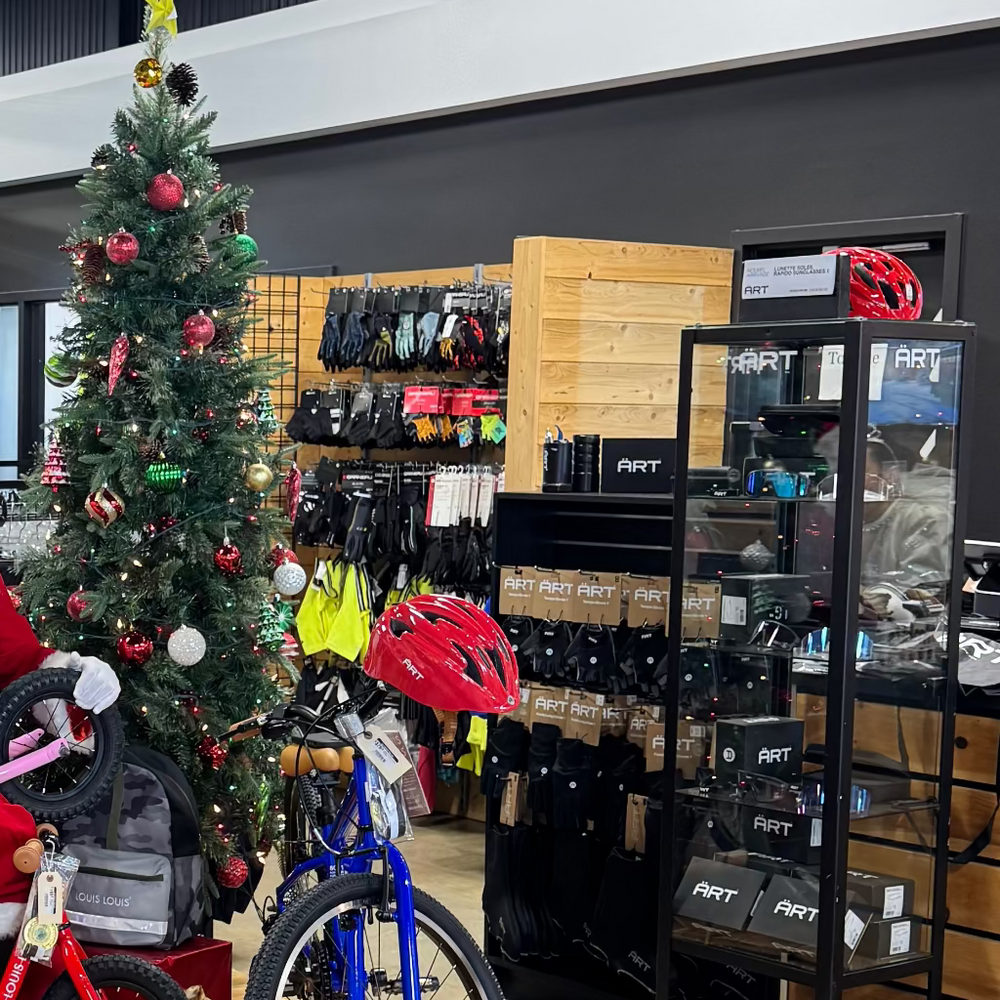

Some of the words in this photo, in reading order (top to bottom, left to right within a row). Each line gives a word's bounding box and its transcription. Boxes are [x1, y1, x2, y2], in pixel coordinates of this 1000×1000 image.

[758, 747, 792, 764] ÄRT
[753, 814, 793, 836] ÄRT
[75, 892, 101, 904] LOUIS
[692, 881, 738, 903] ÄRT
